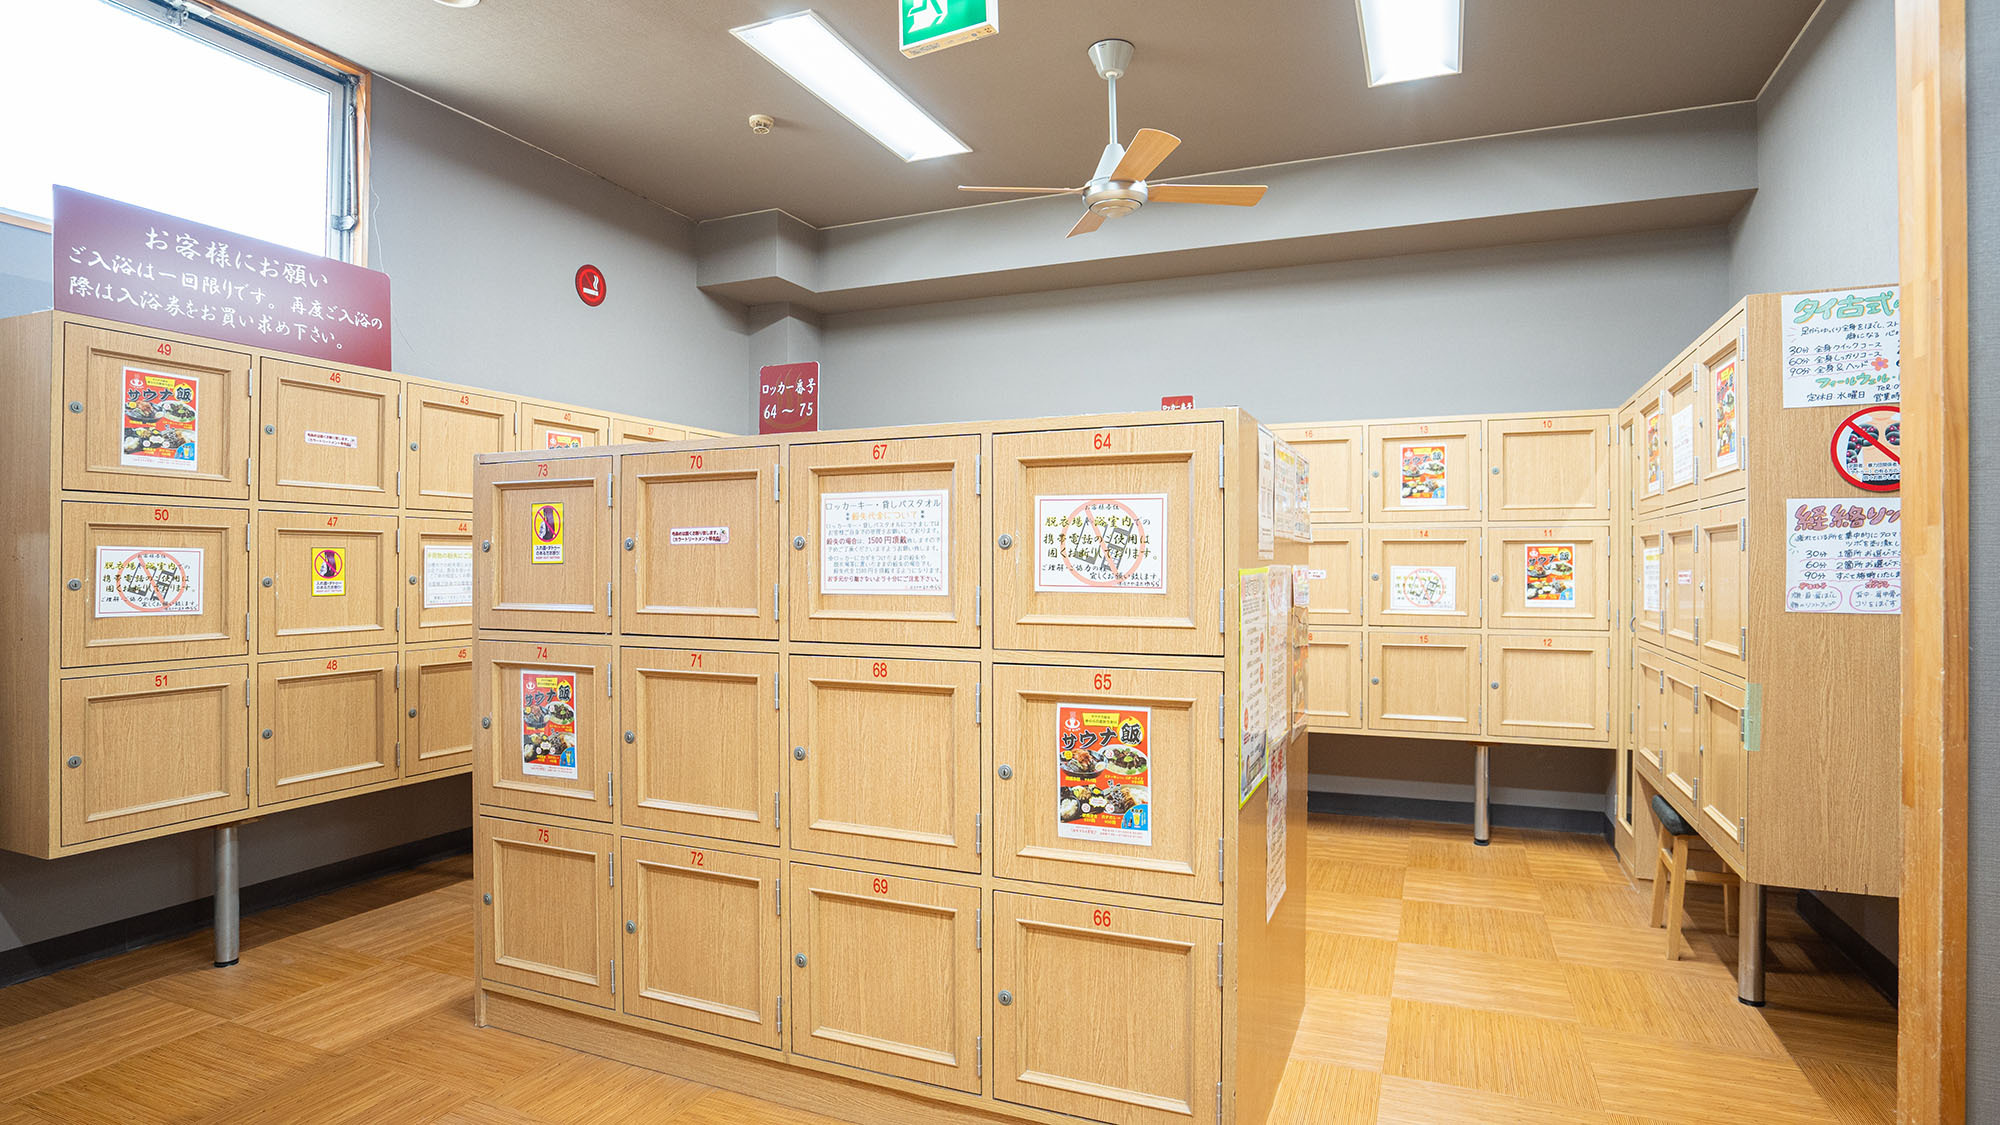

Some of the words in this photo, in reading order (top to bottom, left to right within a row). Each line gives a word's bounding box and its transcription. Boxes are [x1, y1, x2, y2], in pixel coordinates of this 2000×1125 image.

[145, 226, 328, 288] お客様にお願い
[69, 275, 343, 349] 際は入浴券をお買い求め下さい。
[1793, 290, 1900, 324] タイ古式
[157, 344, 171, 356] 49
[1789, 345, 1809, 356] 30分
[1814, 342, 1882, 353] 全身クイックコース
[1789, 356, 1810, 366] 60分
[1814, 351, 1882, 363] 全身しっかりコース
[1789, 367, 1811, 376] 90分
[330, 373, 341, 383] 46
[762, 378, 816, 396] ロッカー番号
[128, 387, 192, 402] サウナ飯
[460, 396, 469, 405] 43
[1837, 390, 1865, 400] 水曜日
[1544, 420, 1552, 428] 10
[1094, 433, 1111, 449] 64
[873, 444, 887, 460] 67
[691, 456, 702, 469] 70
[538, 464, 548, 477] 73
[825, 499, 941, 510] ロッカーキー・貸しバスタオル
[155, 509, 168, 520] 50
[328, 517, 338, 526] 47
[458, 523, 467, 531] 44
[1045, 515, 1151, 527] 脱衣場や浴室内での
[1043, 533, 1150, 545] 携帯電話のご使用は
[1543, 529, 1552, 537] 11
[1805, 550, 1827, 558] 30分
[1805, 560, 1827, 569] 60分
[1420, 635, 1428, 643] 15
[458, 648, 467, 658] 45
[537, 647, 547, 658] 74
[327, 660, 337, 670] 48
[691, 654, 701, 667] 71
[873, 663, 887, 677] 68
[155, 675, 168, 687] 51
[1094, 673, 1111, 690] 65
[525, 685, 571, 706] サウナ飯
[1062, 723, 1141, 750] サウナ飯
[539, 829, 549, 842] 75
[692, 851, 703, 866] 72
[873, 878, 888, 894] 69
[1094, 910, 1111, 927] 66
